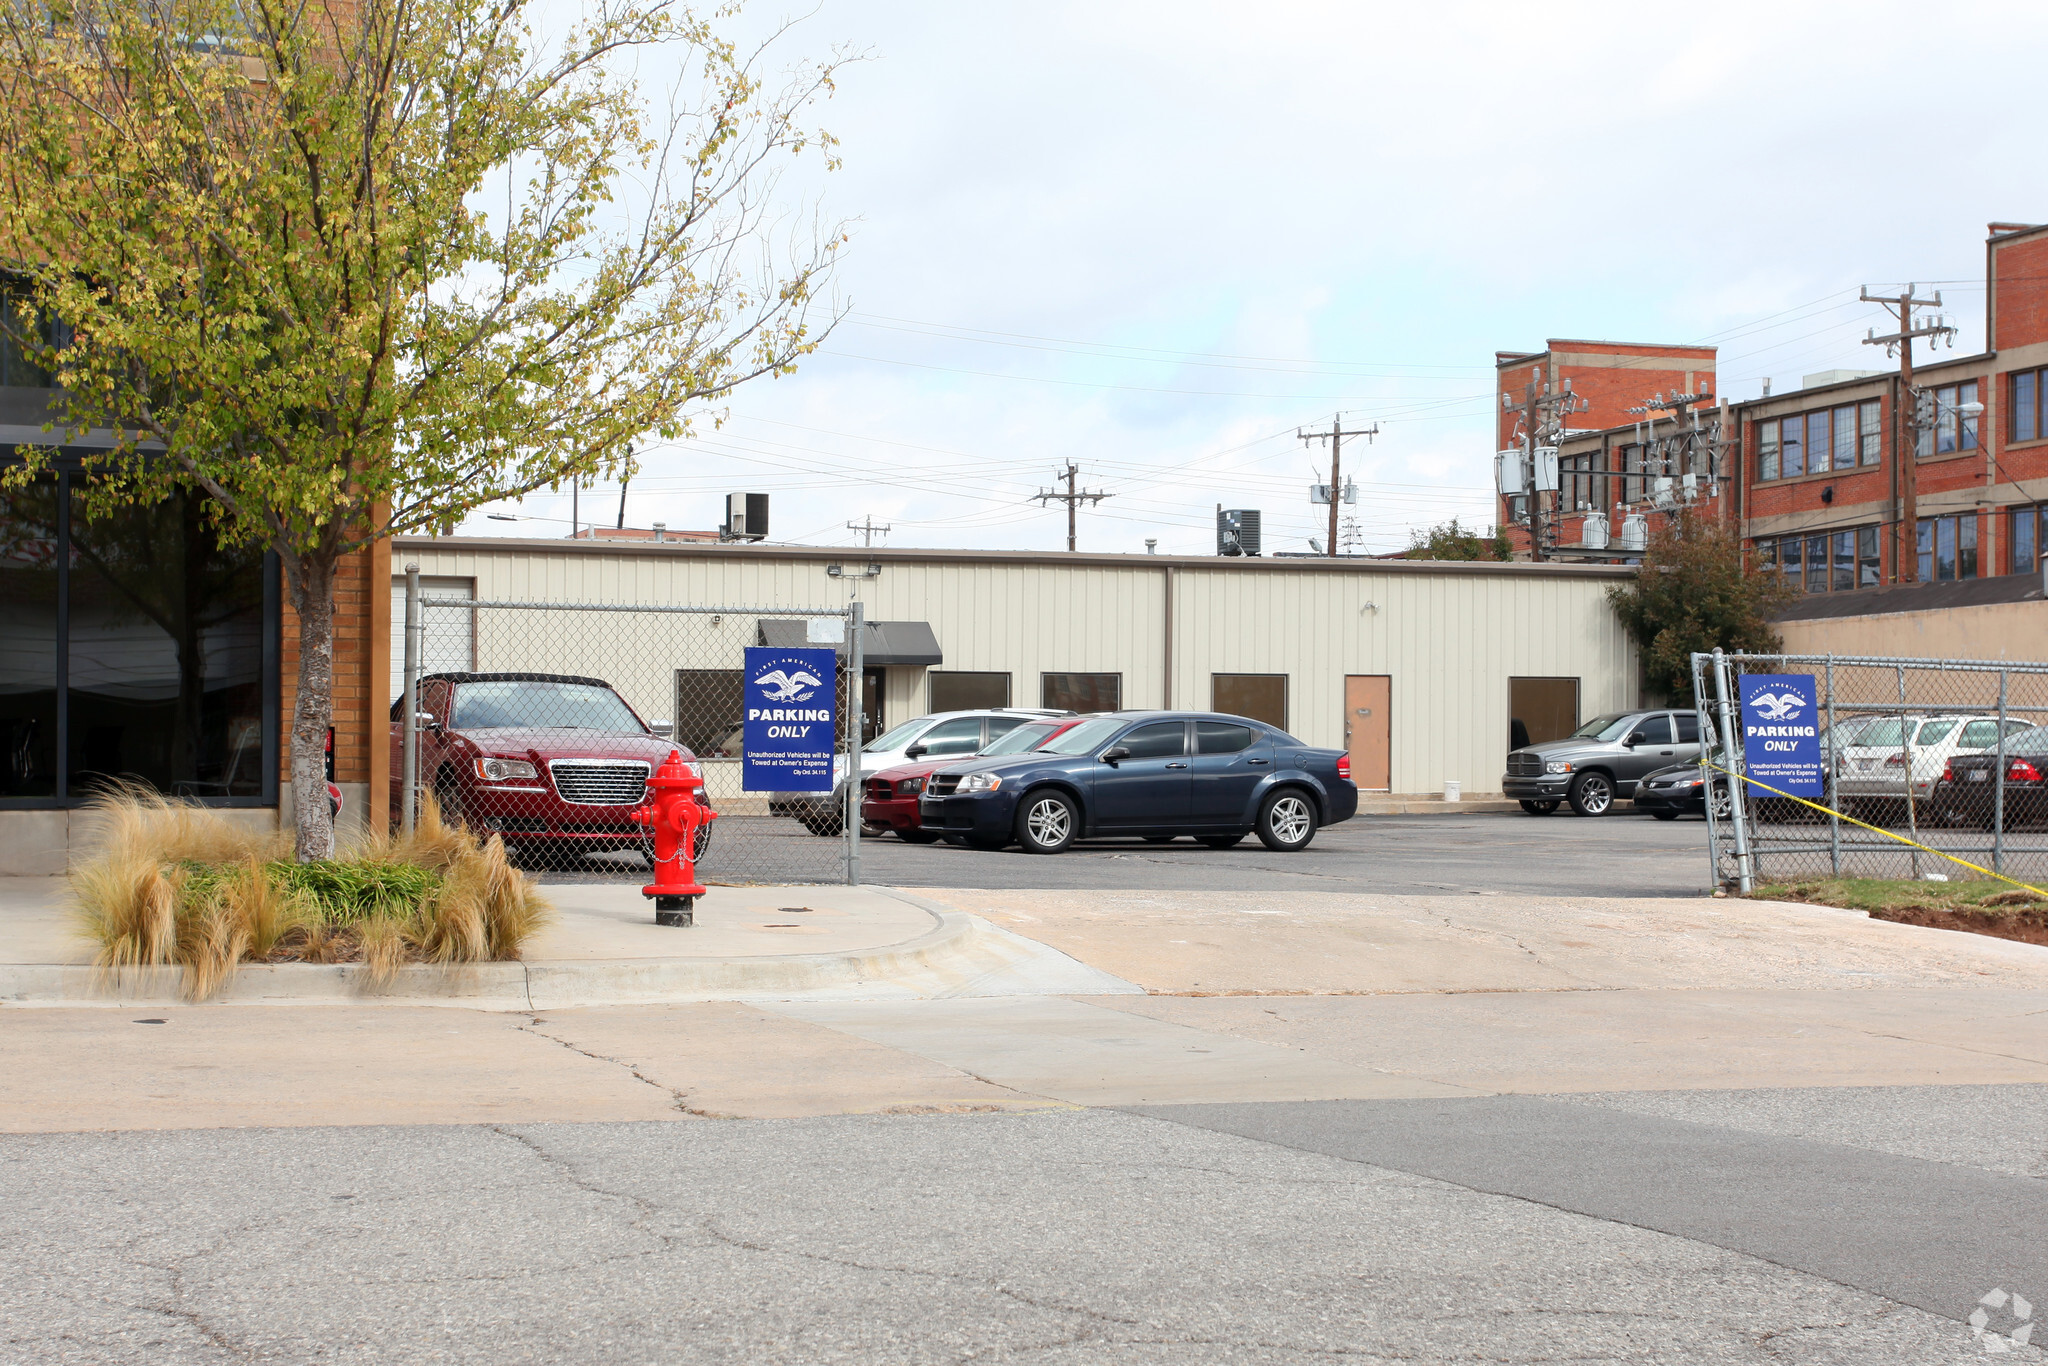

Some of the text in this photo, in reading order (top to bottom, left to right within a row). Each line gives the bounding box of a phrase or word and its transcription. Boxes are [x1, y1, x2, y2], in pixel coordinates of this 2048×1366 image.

[749, 709, 830, 721] PARKING
[768, 726, 810, 738] ONLY
[1747, 726, 1815, 736] PARKING
[1764, 741, 1798, 751] ONLY
